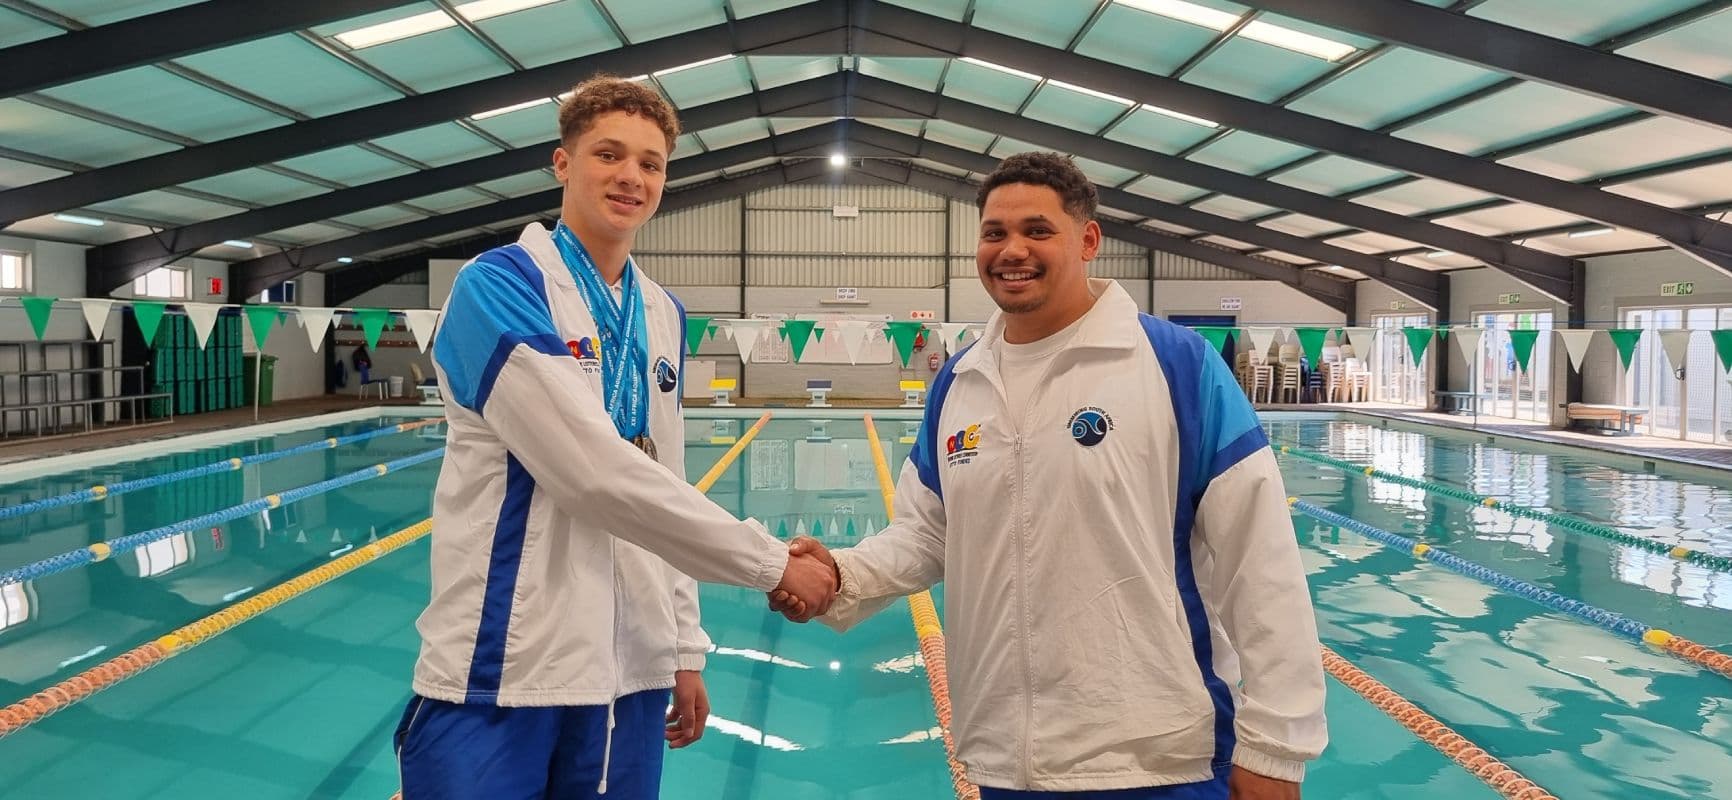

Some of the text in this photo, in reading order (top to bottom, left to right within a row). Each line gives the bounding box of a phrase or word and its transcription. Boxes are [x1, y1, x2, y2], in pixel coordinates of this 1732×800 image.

[1663, 285, 1675, 294] EXIT
[608, 390, 619, 412] AFRICA
[621, 344, 629, 361] ZONE
